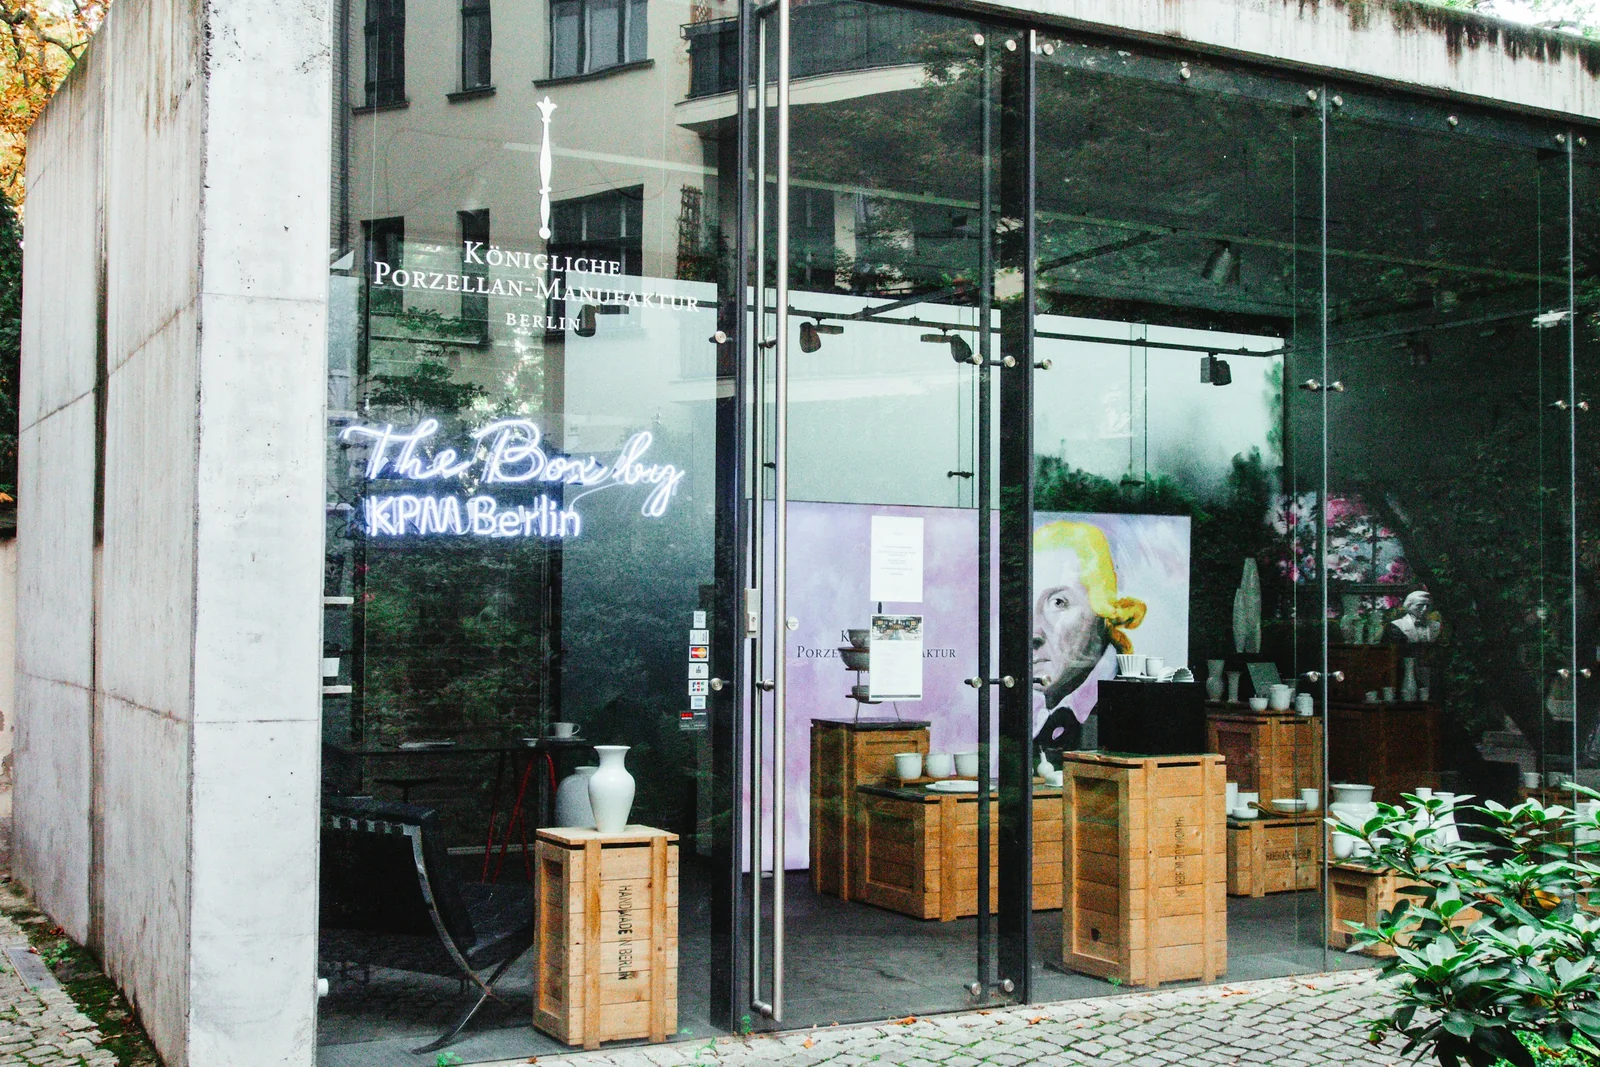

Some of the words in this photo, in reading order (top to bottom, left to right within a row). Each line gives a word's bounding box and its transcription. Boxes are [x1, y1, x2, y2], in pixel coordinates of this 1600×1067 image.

[464, 240, 622, 277] KÖNIGLICHE
[373, 261, 701, 313] PORZELLAN-MANUFAKTUR
[505, 313, 582, 332] BERLIN
[340, 418, 470, 480] The
[473, 419, 607, 484] Box
[612, 430, 685, 518] by
[367, 495, 464, 537] KPM
[472, 494, 582, 538] Berlin
[618, 885, 633, 935] HANDMADE
[618, 937, 633, 946] IN
[618, 948, 633, 980] BERLIN
